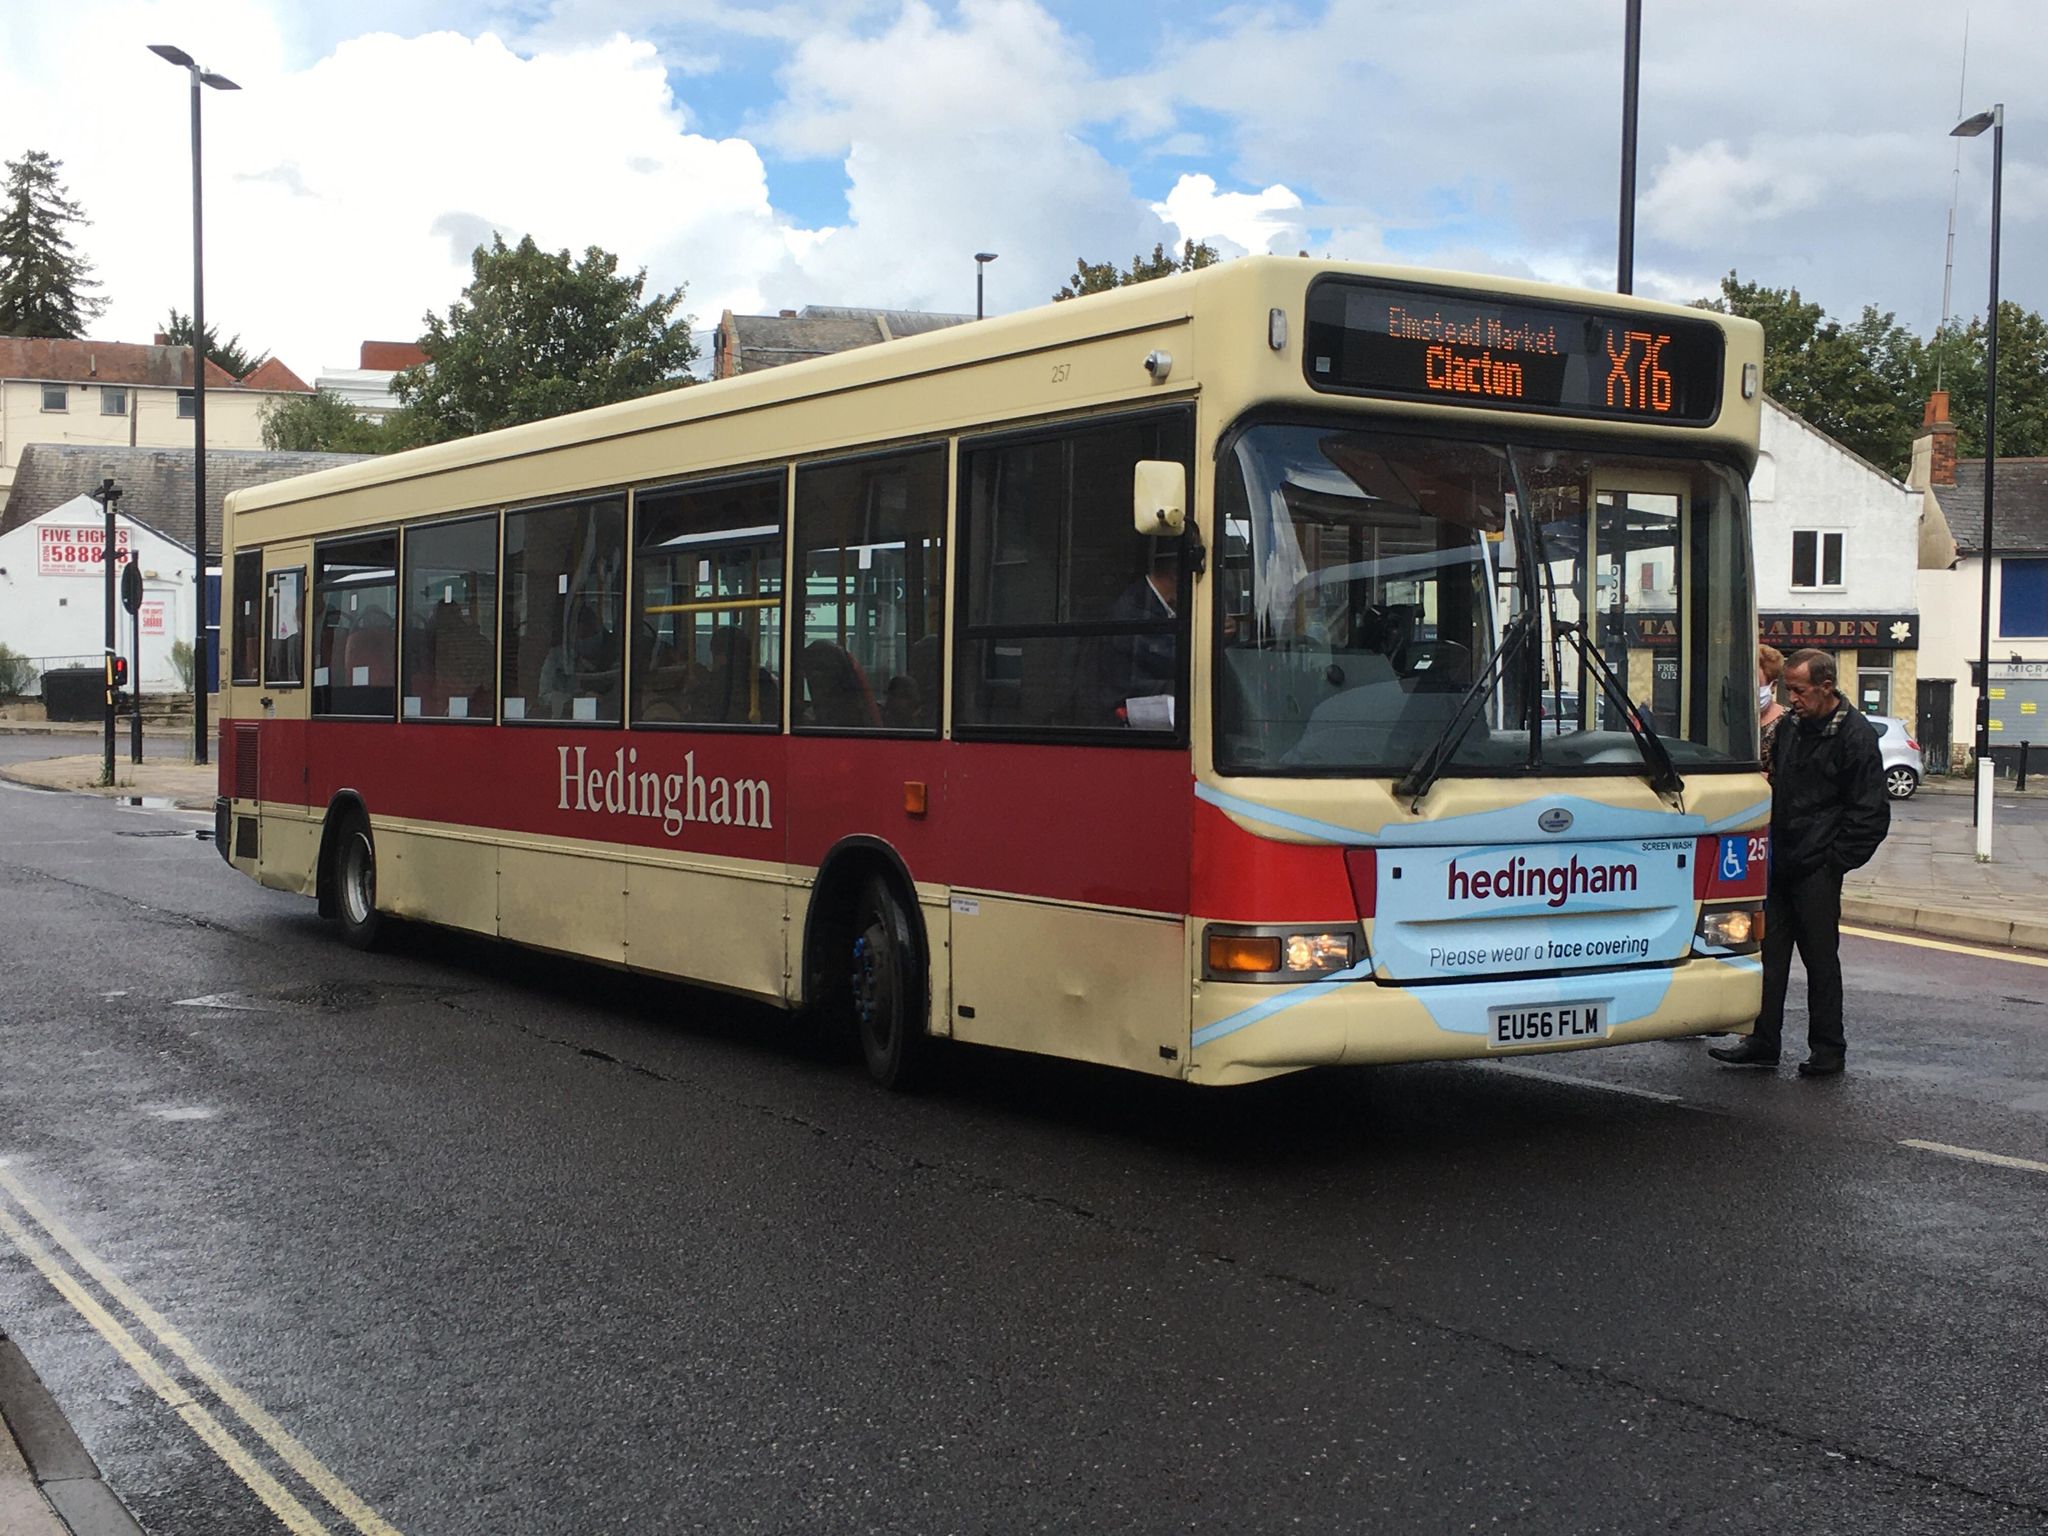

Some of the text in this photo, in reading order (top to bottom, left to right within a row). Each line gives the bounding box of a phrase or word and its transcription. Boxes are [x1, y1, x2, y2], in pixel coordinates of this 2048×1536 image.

[1389, 307, 1559, 354] Elmstead Market
[1051, 363, 1072, 384] 257
[1426, 345, 1523, 396] Clacton
[1606, 328, 1672, 411] X76
[42, 528, 71, 543] FIVE
[51, 545, 129, 564] 58888
[1639, 619, 1678, 636] TA
[1657, 663, 1678, 672] FRE
[557, 745, 773, 837] Hedingham
[1641, 841, 1693, 851] SCREEN WASH
[1448, 854, 1638, 908] hedingham
[1430, 935, 1650, 967] Please wear a face covering
[1498, 1007, 1599, 1042] EU56 FLM
